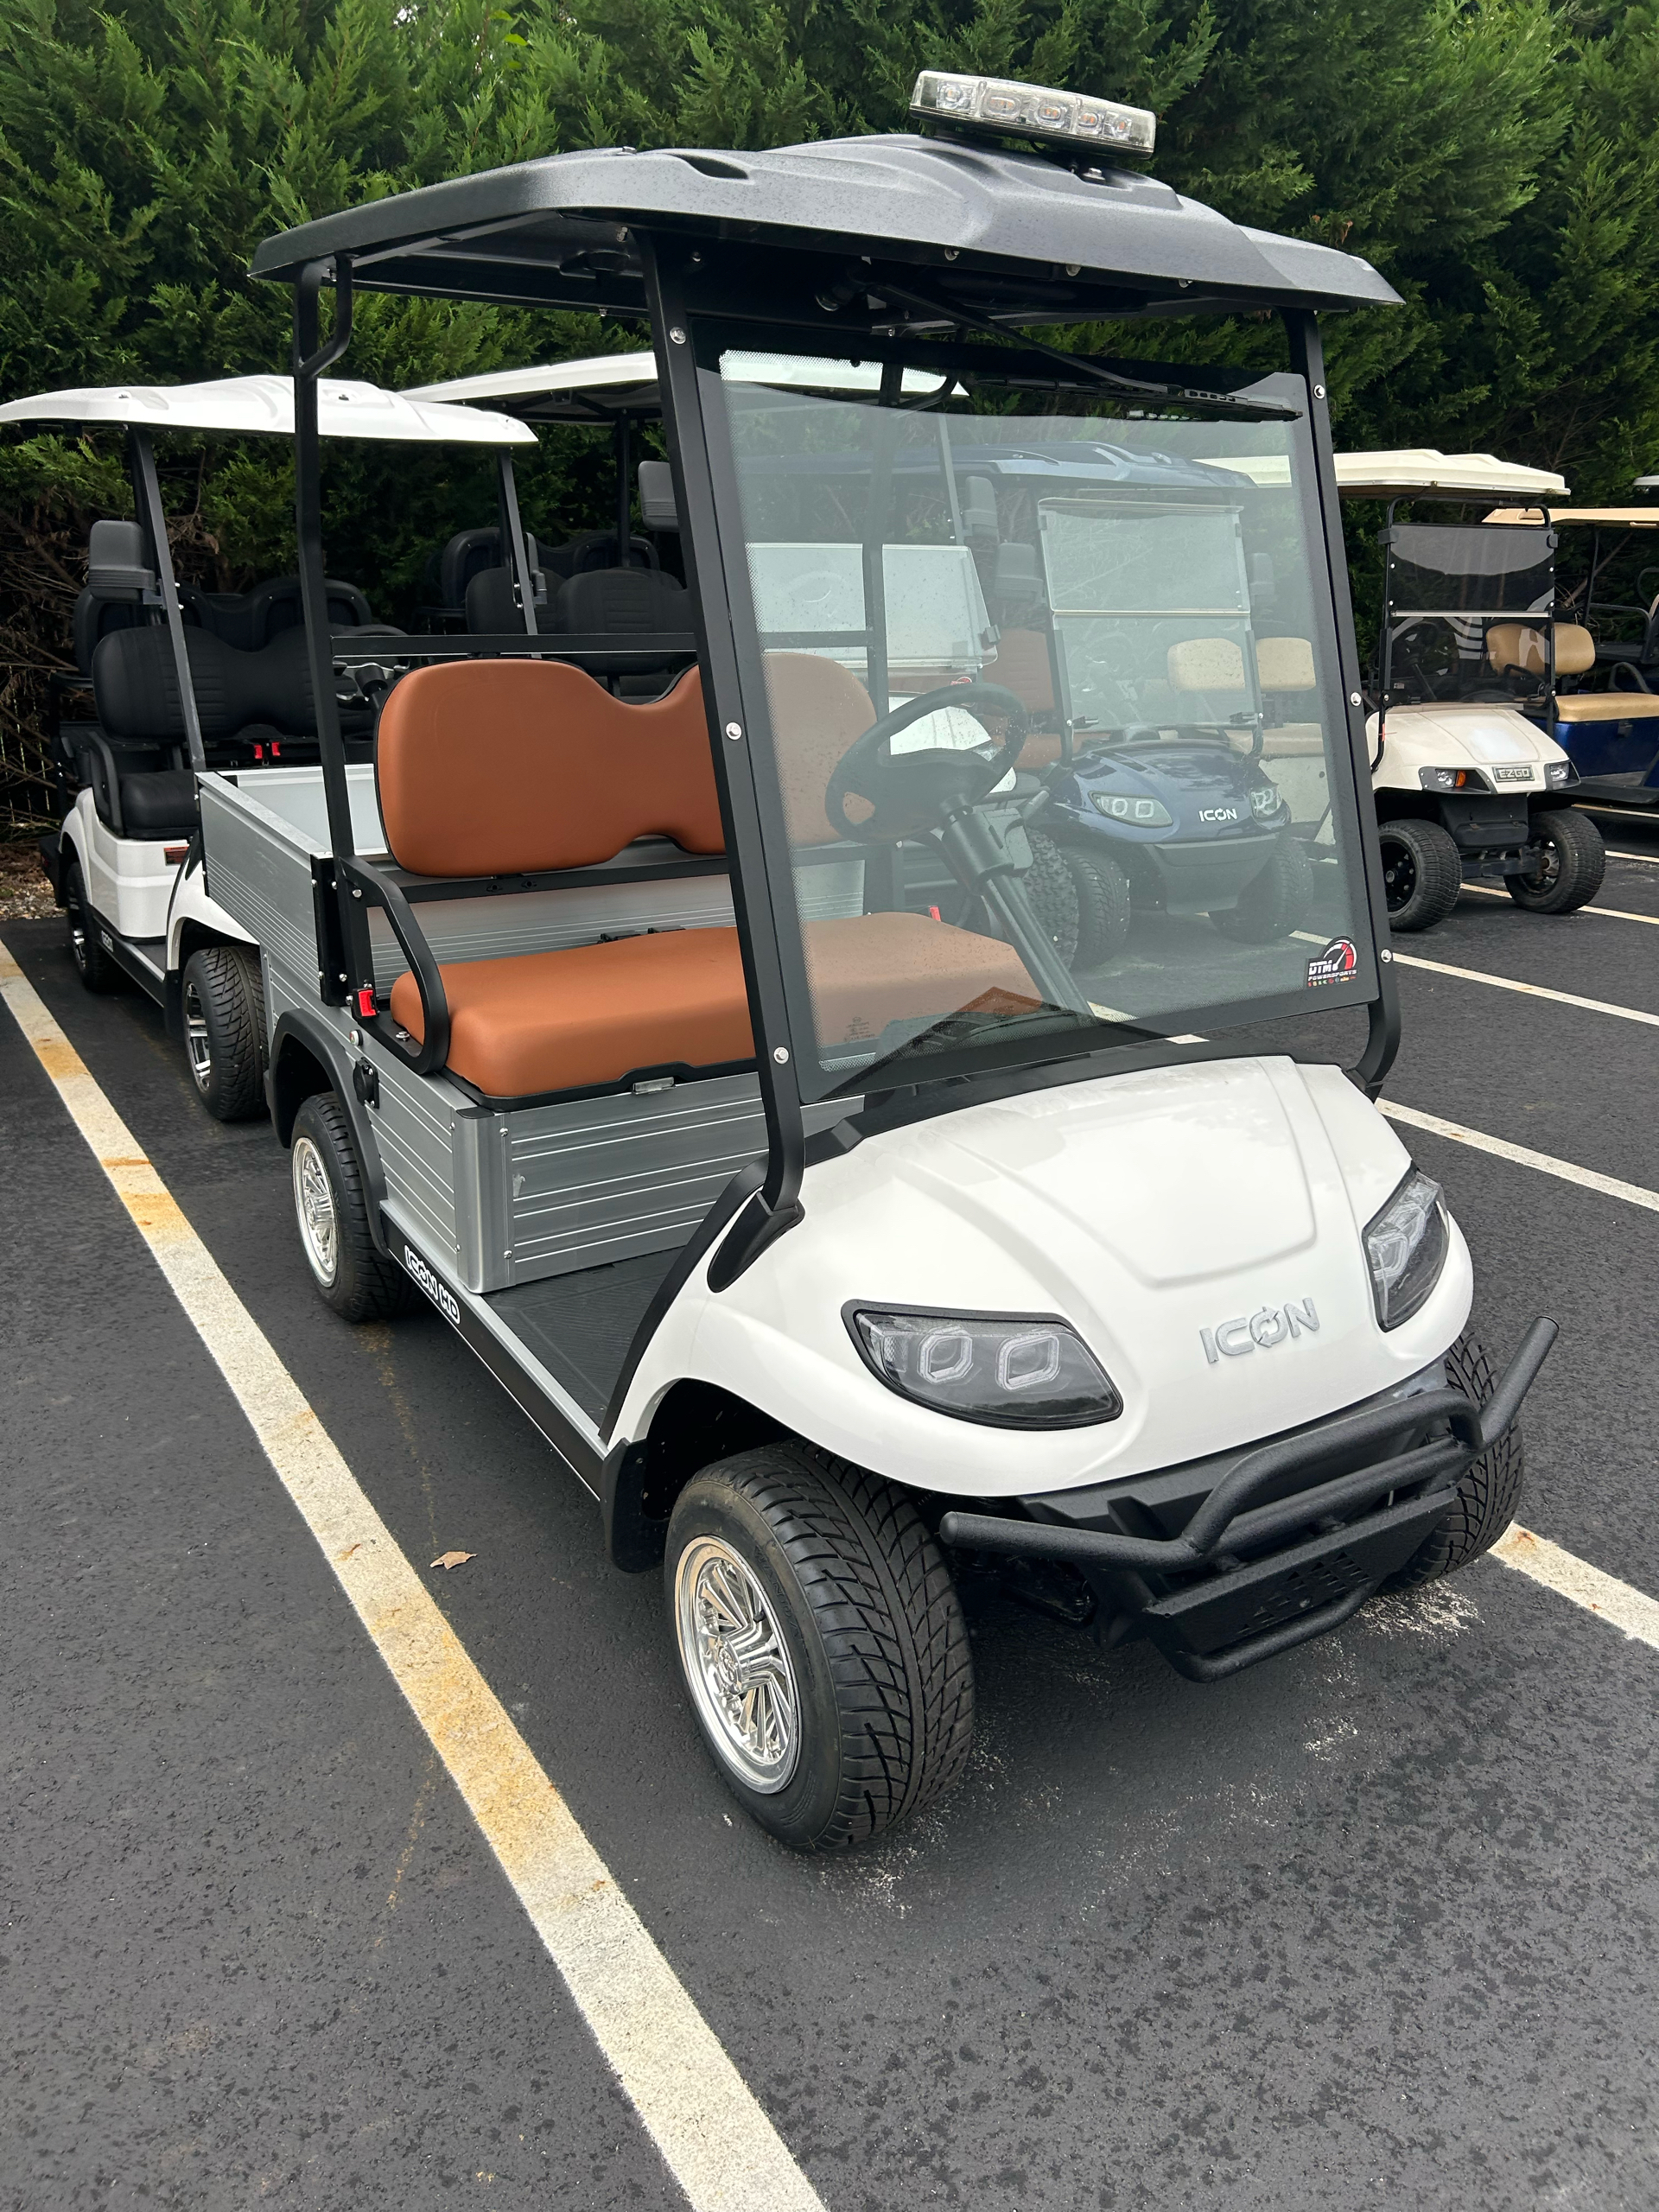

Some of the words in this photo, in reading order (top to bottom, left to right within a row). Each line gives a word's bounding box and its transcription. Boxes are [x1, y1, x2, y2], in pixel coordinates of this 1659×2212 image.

[1198, 808, 1238, 822] ICON
[1307, 969, 1357, 982] POWERSPORTS
[404, 1244, 438, 1300] ICON
[438, 1283, 461, 1324] HD
[1199, 1297, 1320, 1364] ICON
